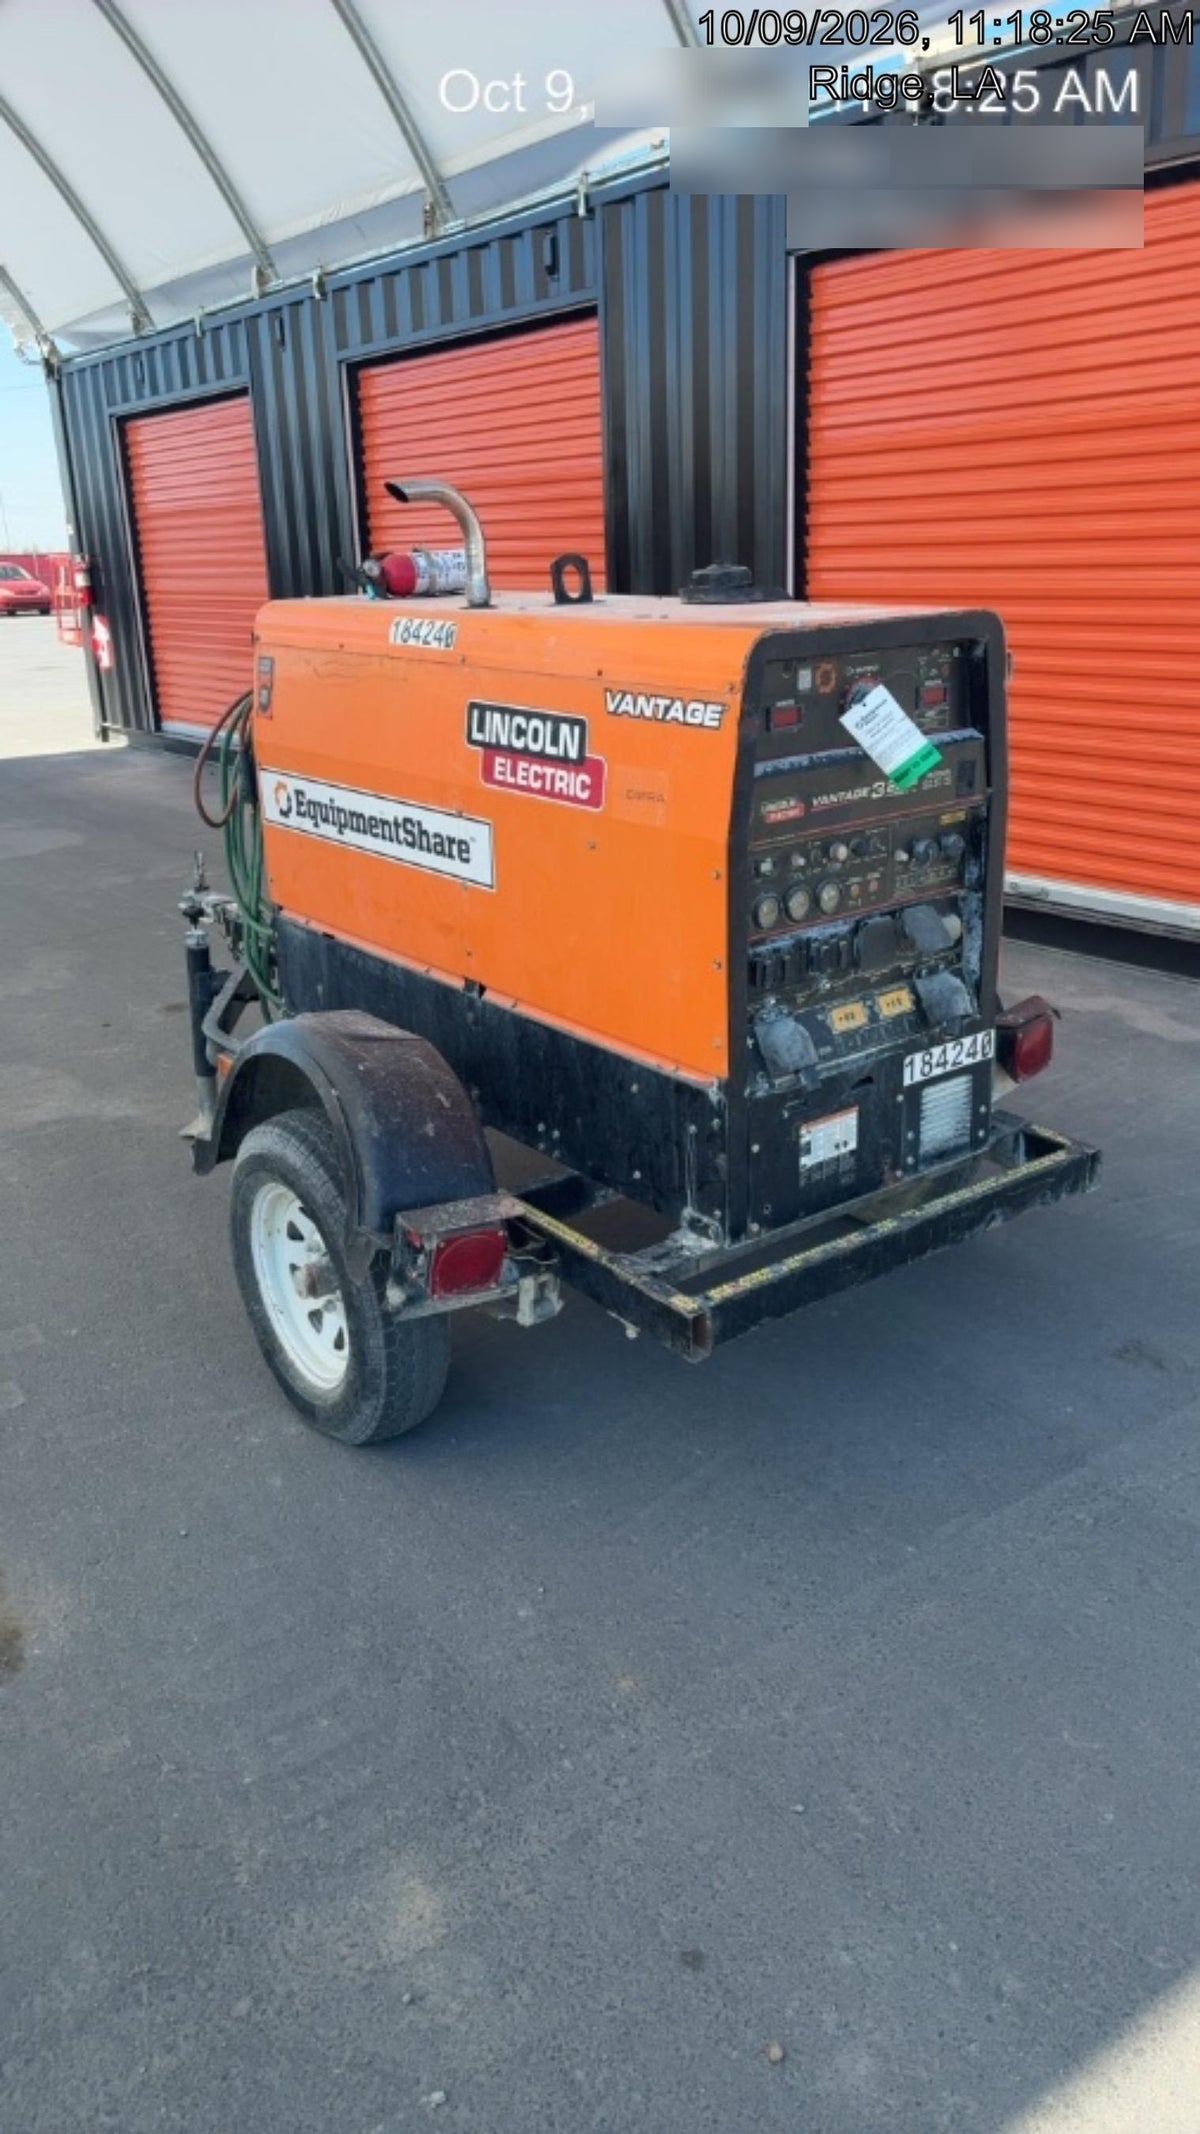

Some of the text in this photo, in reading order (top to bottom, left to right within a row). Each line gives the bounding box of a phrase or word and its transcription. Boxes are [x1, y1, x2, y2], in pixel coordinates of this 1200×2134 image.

[470, 708, 580, 761] LINCOLN
[604, 689, 723, 729] VANTAGE
[492, 755, 592, 801] ELECTRIC
[293, 789, 471, 864] EquipmentShare
[904, 1029, 992, 1083] 184240
